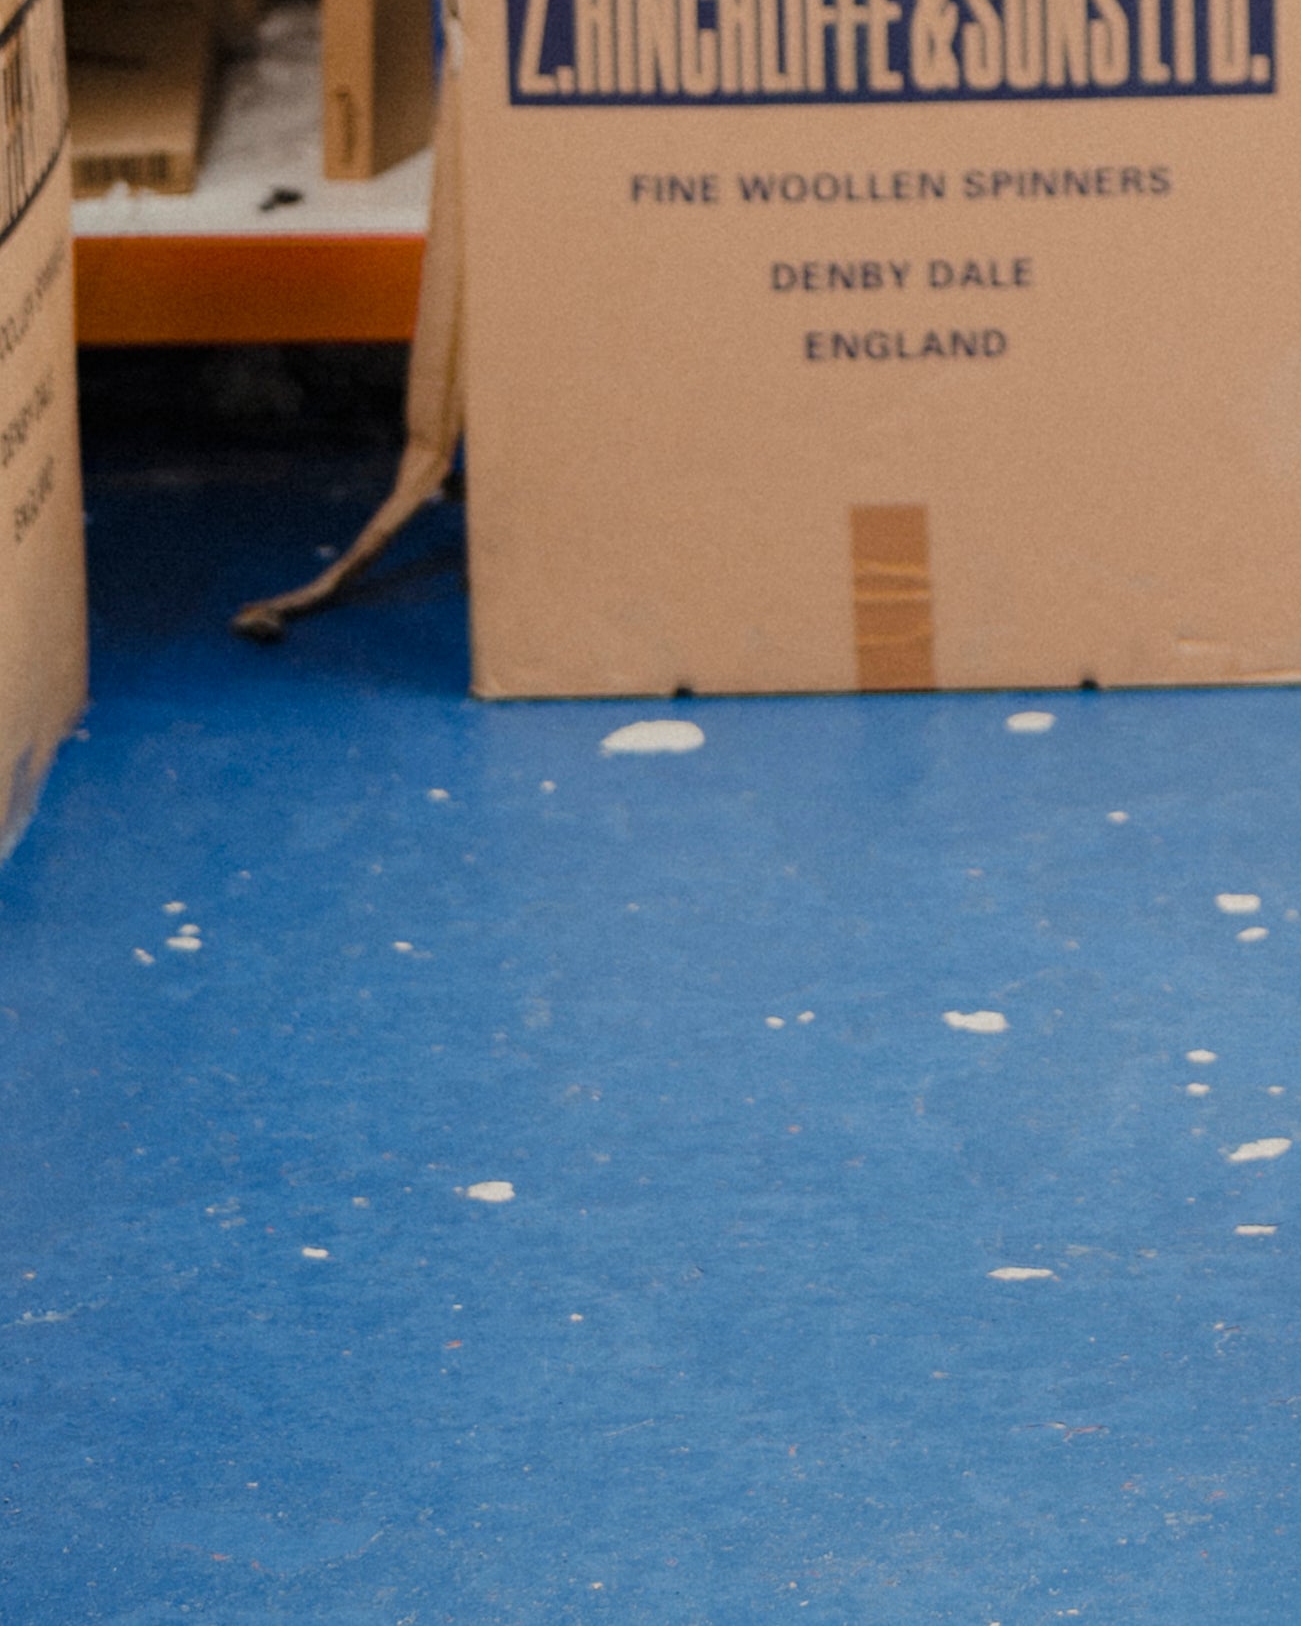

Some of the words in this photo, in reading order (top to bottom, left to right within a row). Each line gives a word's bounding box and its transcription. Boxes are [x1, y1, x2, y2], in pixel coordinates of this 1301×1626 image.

[630, 172, 719, 205] FINE
[738, 169, 947, 203] WOOLLEN
[963, 165, 1174, 200] SPINNERS
[770, 259, 911, 293] DENBY
[928, 256, 1034, 290] DALE
[804, 327, 1008, 362] ENGLAND
